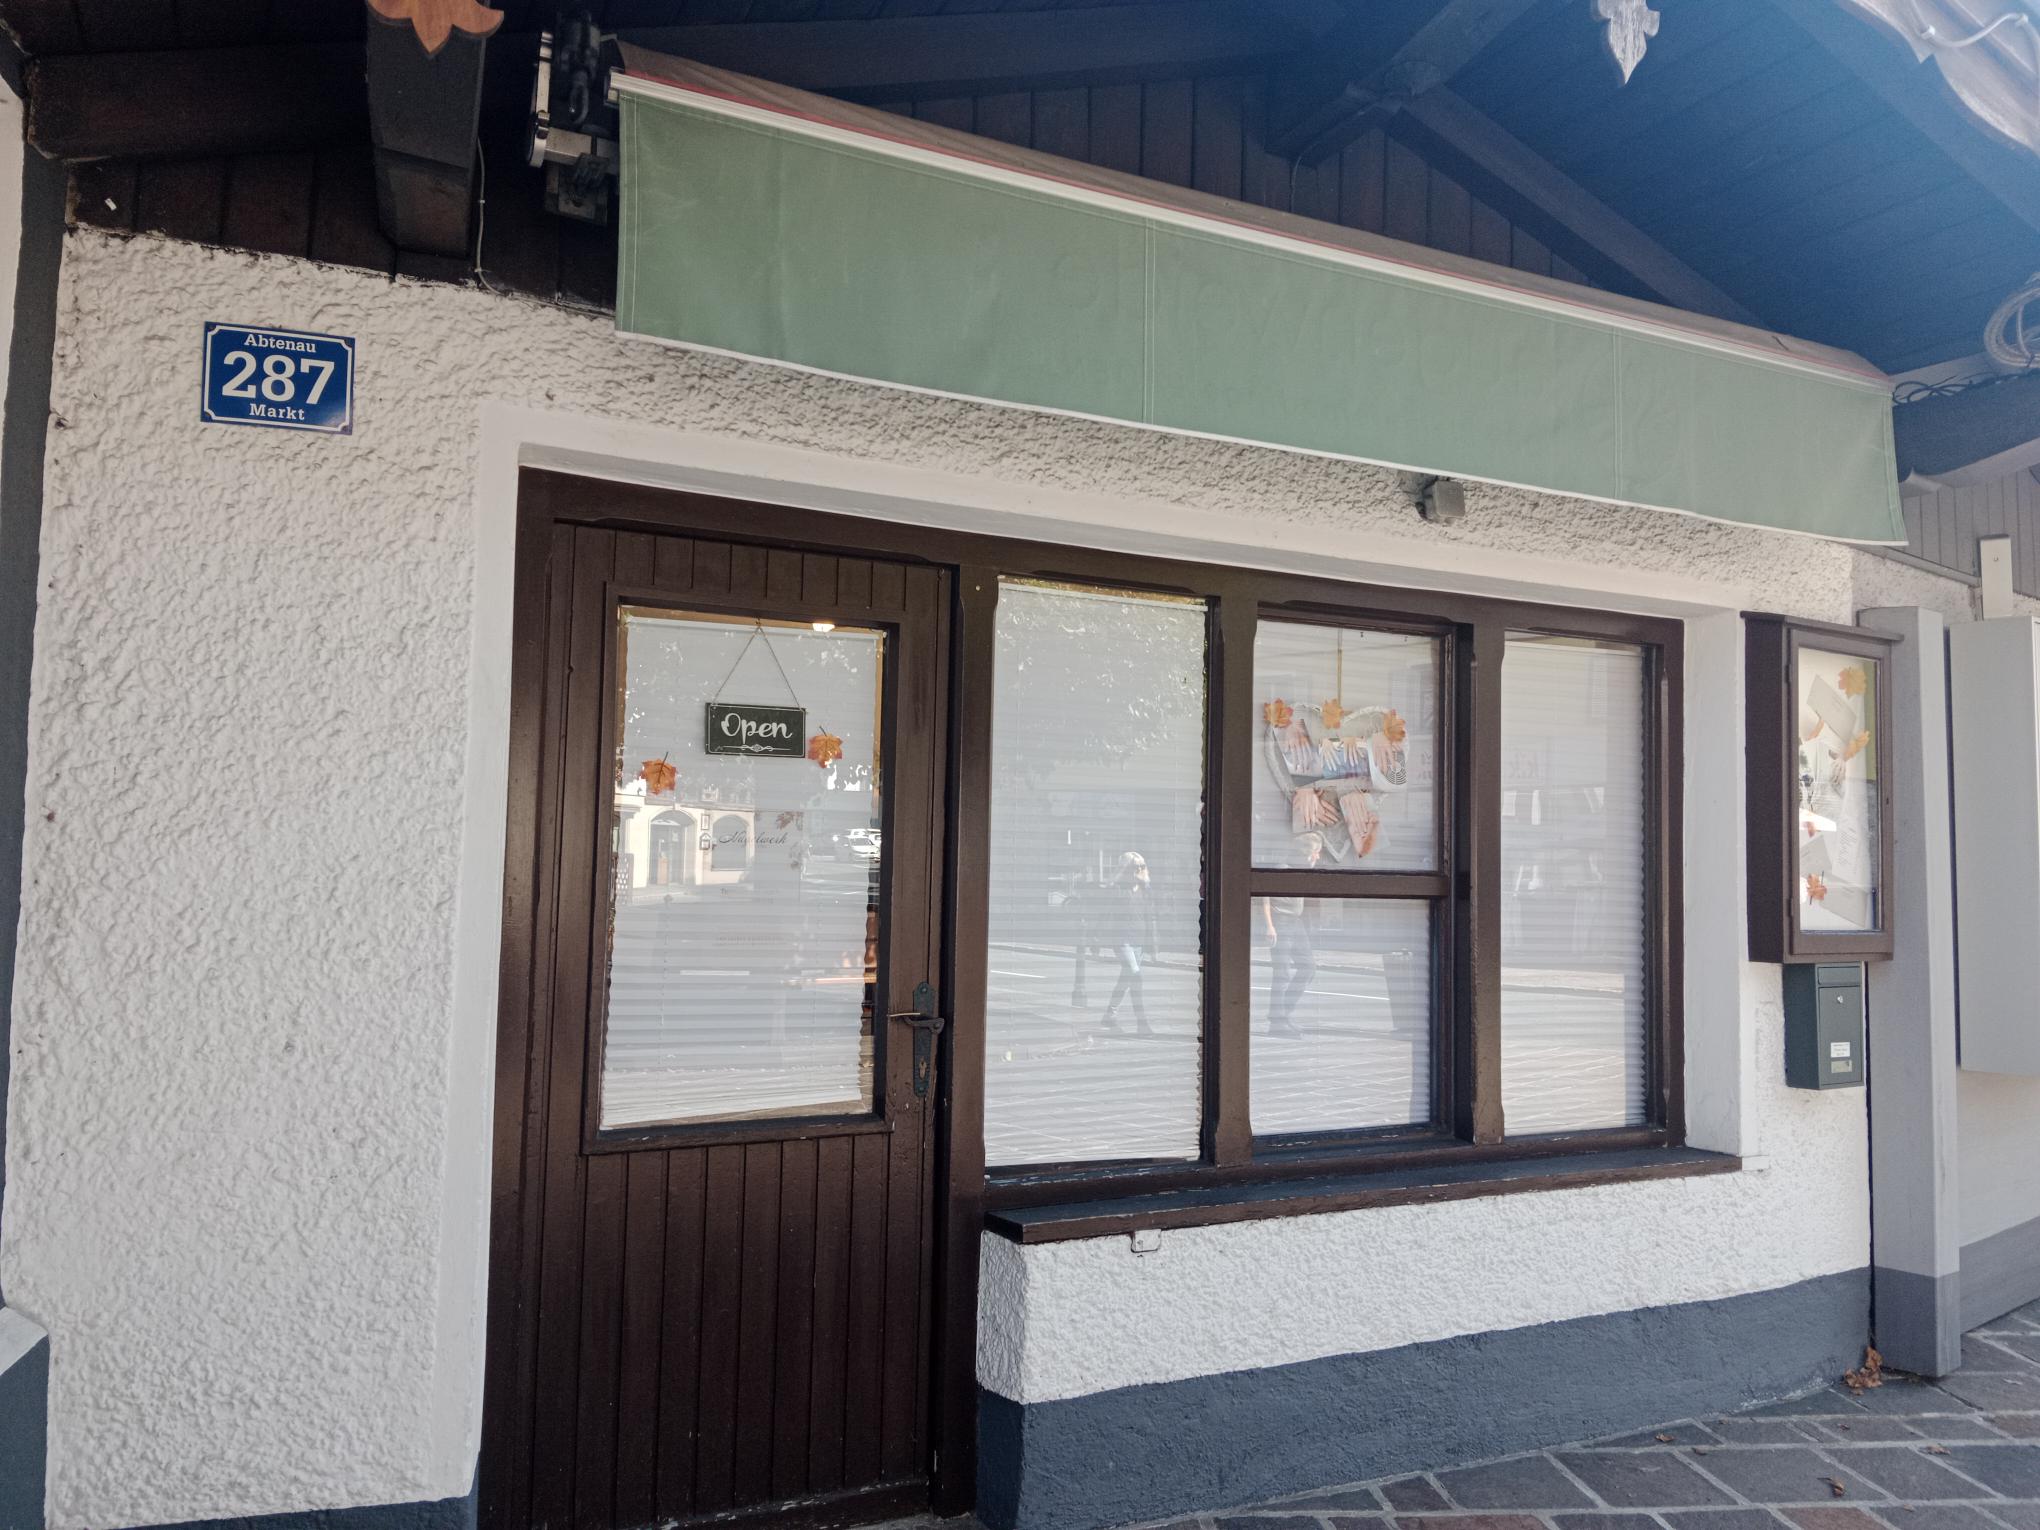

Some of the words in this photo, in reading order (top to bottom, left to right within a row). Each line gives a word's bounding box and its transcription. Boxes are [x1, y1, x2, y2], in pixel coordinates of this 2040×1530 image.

[244, 334, 316, 353] Abtenau
[222, 350, 335, 405] 287
[249, 403, 305, 420] Markt
[720, 712, 793, 744] Open
